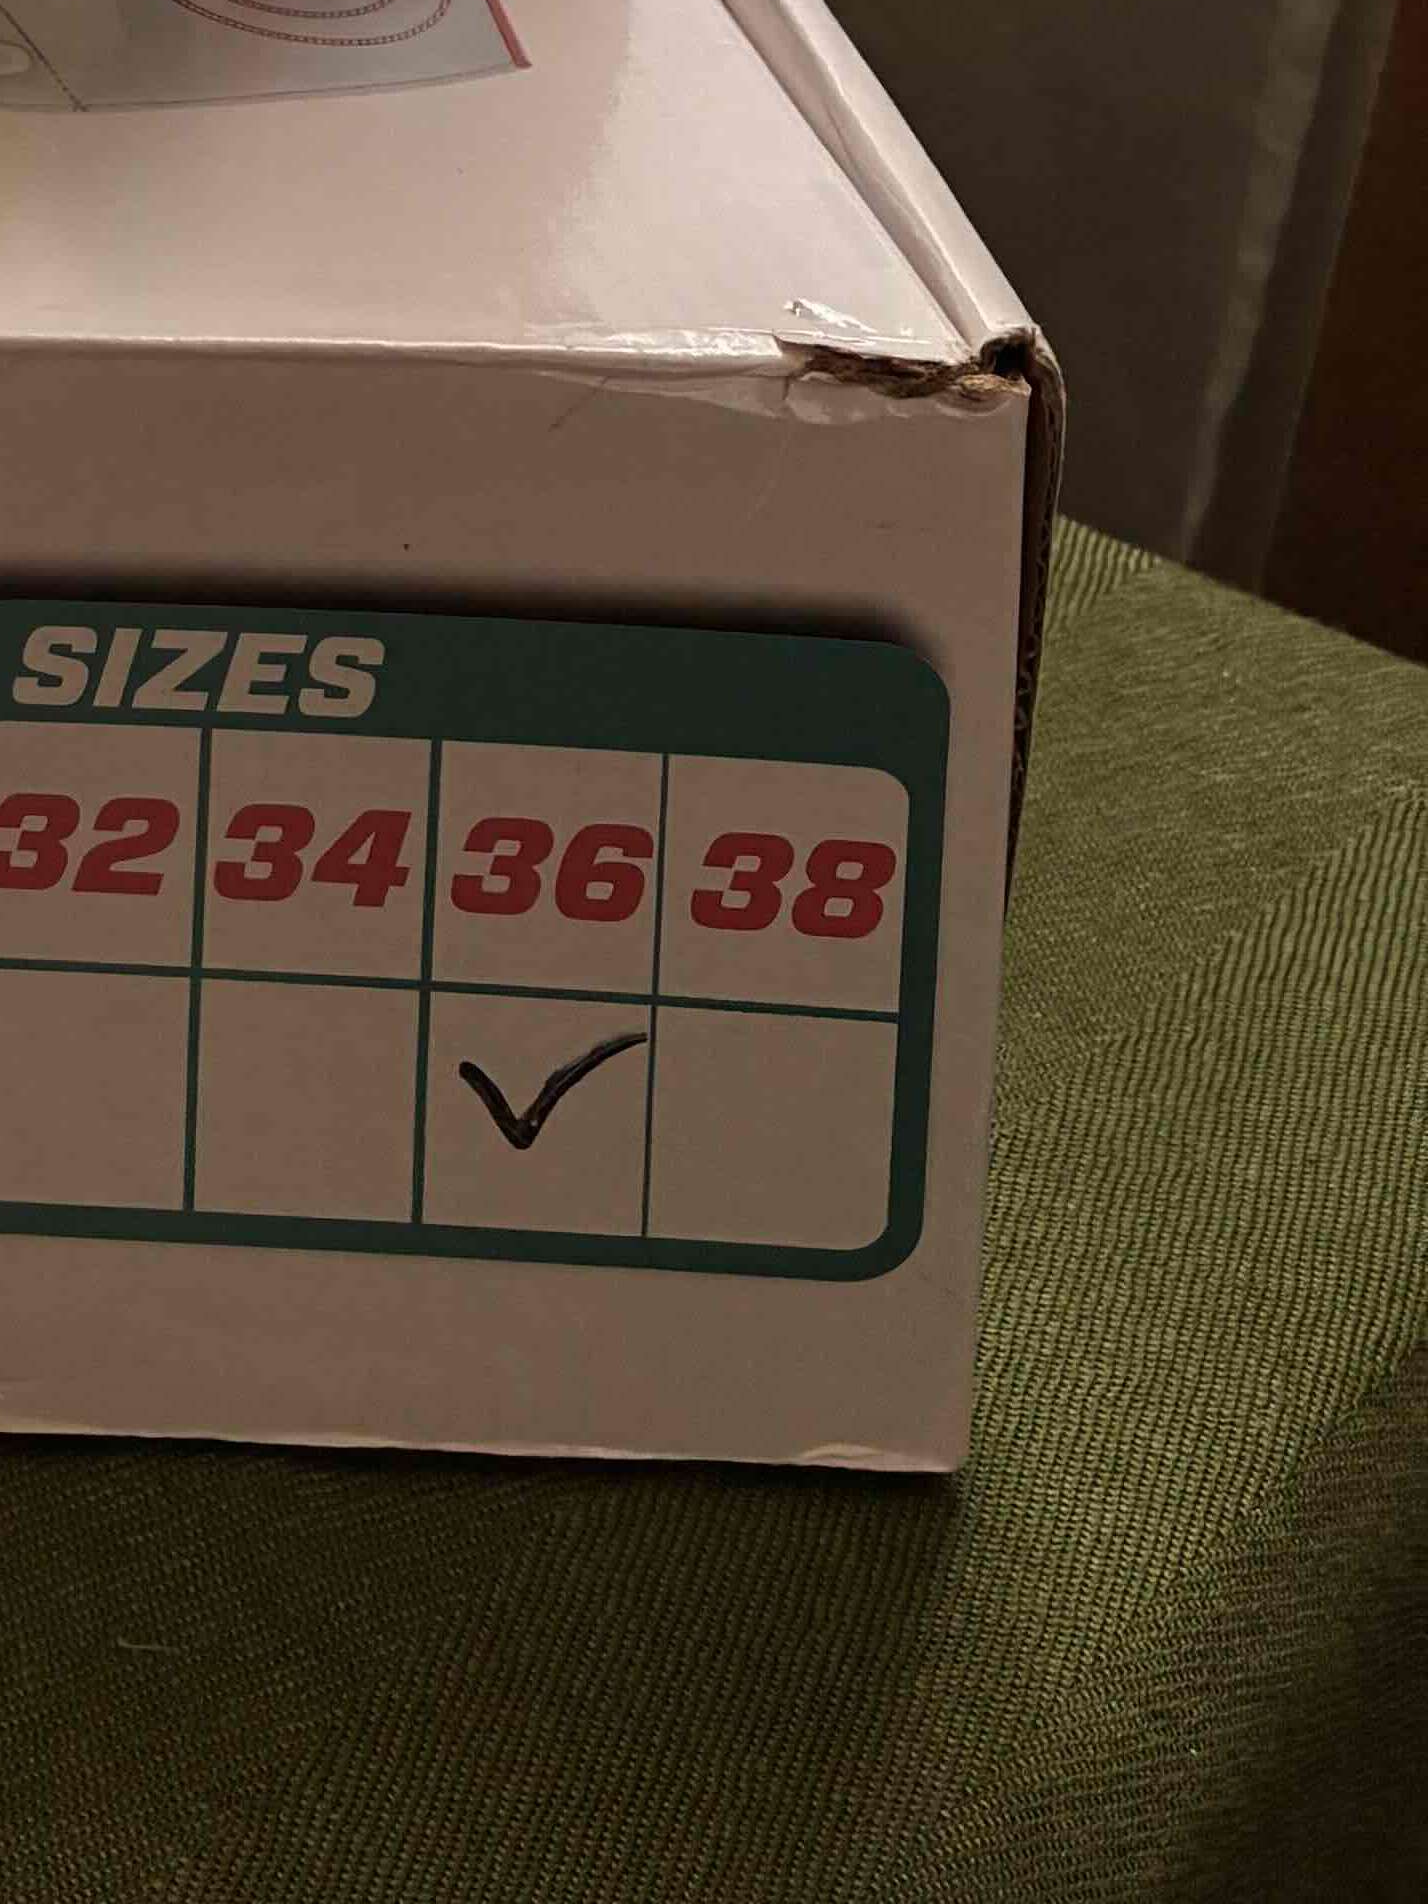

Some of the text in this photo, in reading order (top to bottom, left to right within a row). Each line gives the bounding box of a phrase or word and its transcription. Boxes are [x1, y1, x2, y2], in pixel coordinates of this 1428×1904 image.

[11, 626, 386, 719] SIZES
[212, 803, 411, 908] 34
[449, 817, 655, 924] 36
[689, 831, 897, 940] 38
